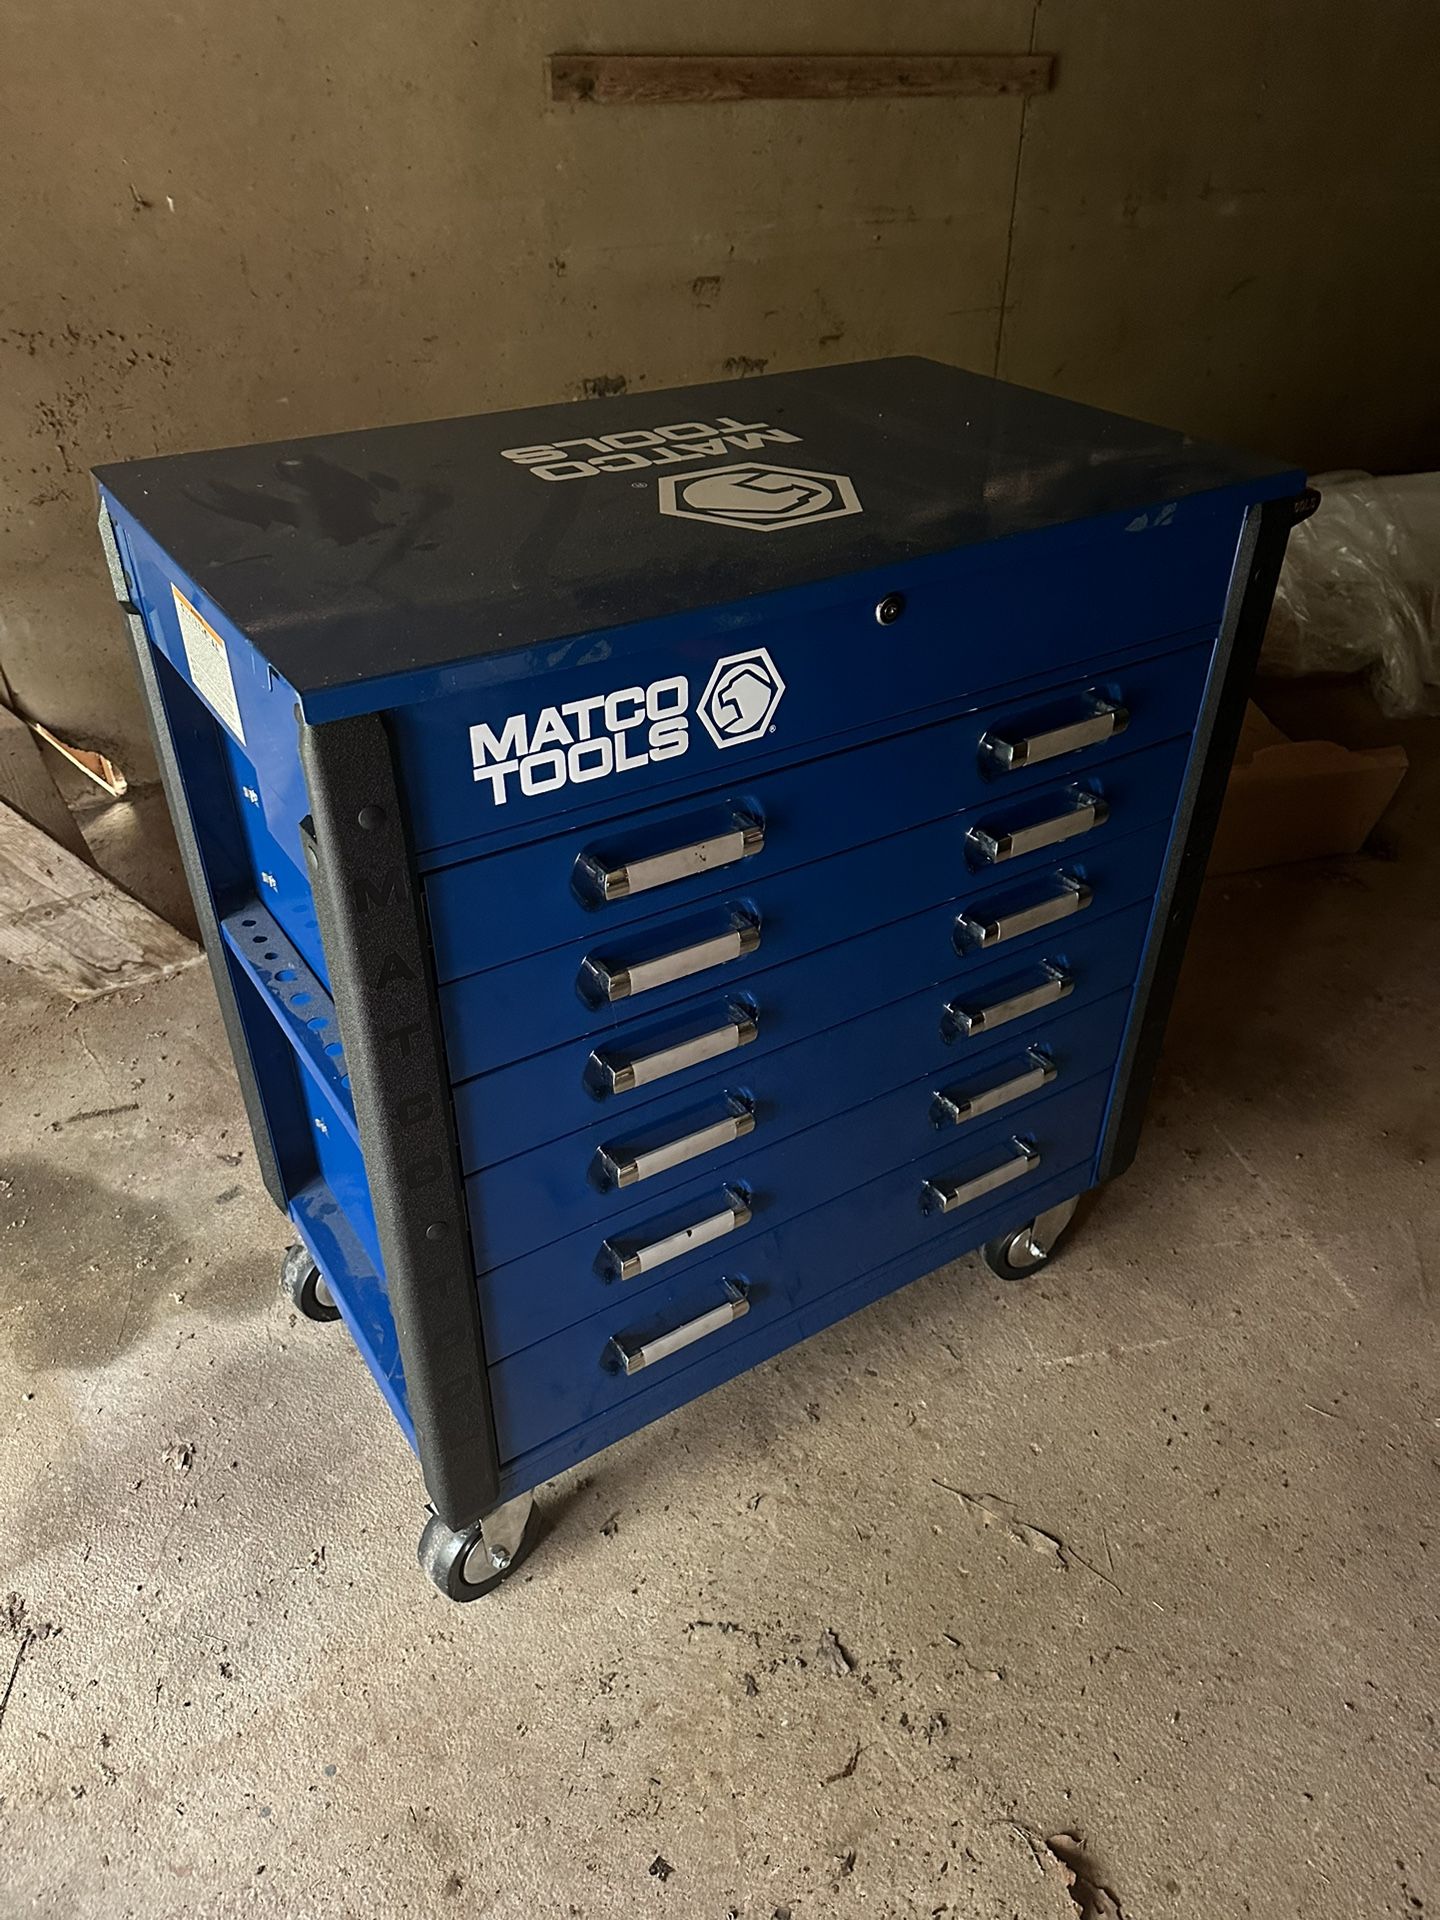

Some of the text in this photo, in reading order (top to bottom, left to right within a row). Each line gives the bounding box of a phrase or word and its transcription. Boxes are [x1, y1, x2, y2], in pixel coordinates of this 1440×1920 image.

[500, 417, 769, 465] TOOLS
[529, 428, 803, 482] MATCO
[469, 675, 689, 768] MATCO
[472, 716, 689, 806] TOOLS
[354, 865, 488, 1492] MATCO TOOL
